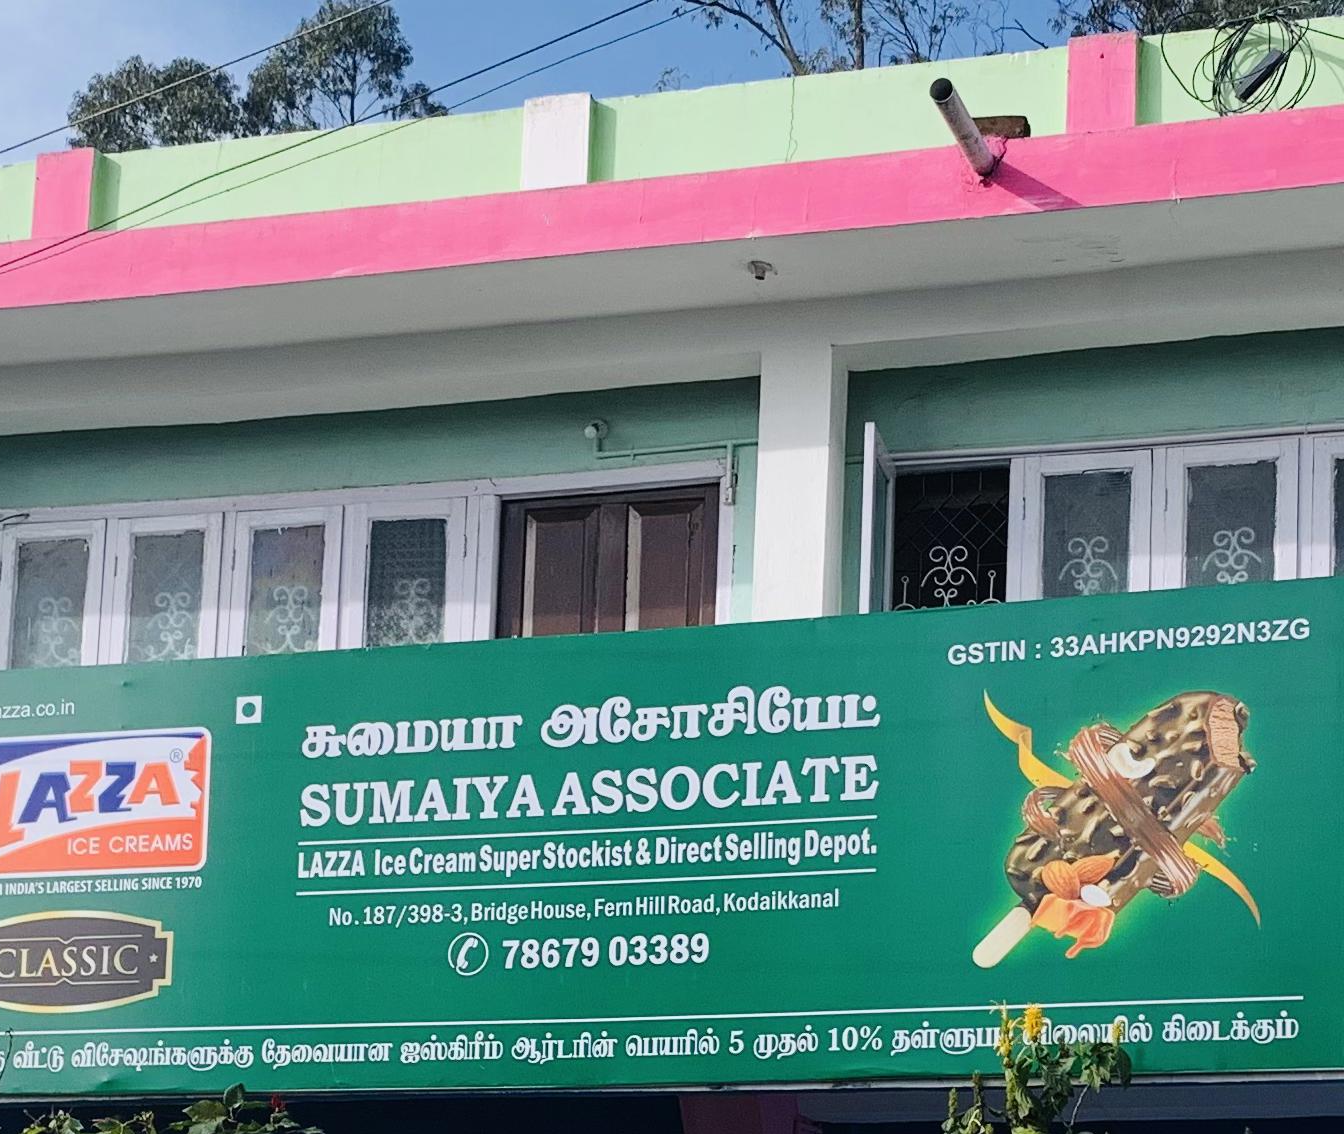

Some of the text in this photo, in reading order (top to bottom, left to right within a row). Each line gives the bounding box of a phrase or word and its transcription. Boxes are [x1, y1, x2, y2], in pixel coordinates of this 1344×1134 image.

[947, 640, 1026, 666] GSTIN
[1050, 617, 1311, 658] 33AHKPN9292N3ZG
[301, 684, 881, 759] சுமையா அசோசியேட்
[299, 754, 880, 827] SUMAIYA ASSOCIATE
[67, 833, 193, 856] ICE CREAMS
[298, 826, 877, 879] LAZZA Ice Cream Super Stockist & Direct Selling Depot.
[5, 880, 45, 896] INDIA'S
[46, 879, 94, 895] LARGEST
[95, 878, 140, 893] SELLING
[141, 877, 173, 891] SINCE
[175, 876, 203, 890] 1970
[471, 902, 529, 925] Bridge
[531, 900, 591, 922] House,
[594, 897, 633, 918] Fern
[635, 895, 666, 916] Hill
[668, 893, 721, 917] Road,
[723, 887, 840, 912] Kodaikkanal
[501, 932, 710, 969] 78679 03389
[12, 1040, 65, 1073] வீட்டு
[71, 1039, 254, 1073] விசேஷங்களுக்கு
[261, 1037, 393, 1070] தேவையான
[400, 1030, 504, 1065] ஐஸ்கிரீம்
[510, 1029, 618, 1069] ஆர்டரின்
[625, 1026, 721, 1058] பெயரில்
[728, 1029, 745, 1055] 5
[753, 1024, 819, 1060] முதல்
[827, 1024, 883, 1053] 10%
[891, 1020, 1014, 1057] தள்ளுப
[1162, 1009, 1300, 1045] கிடைக்கும்
